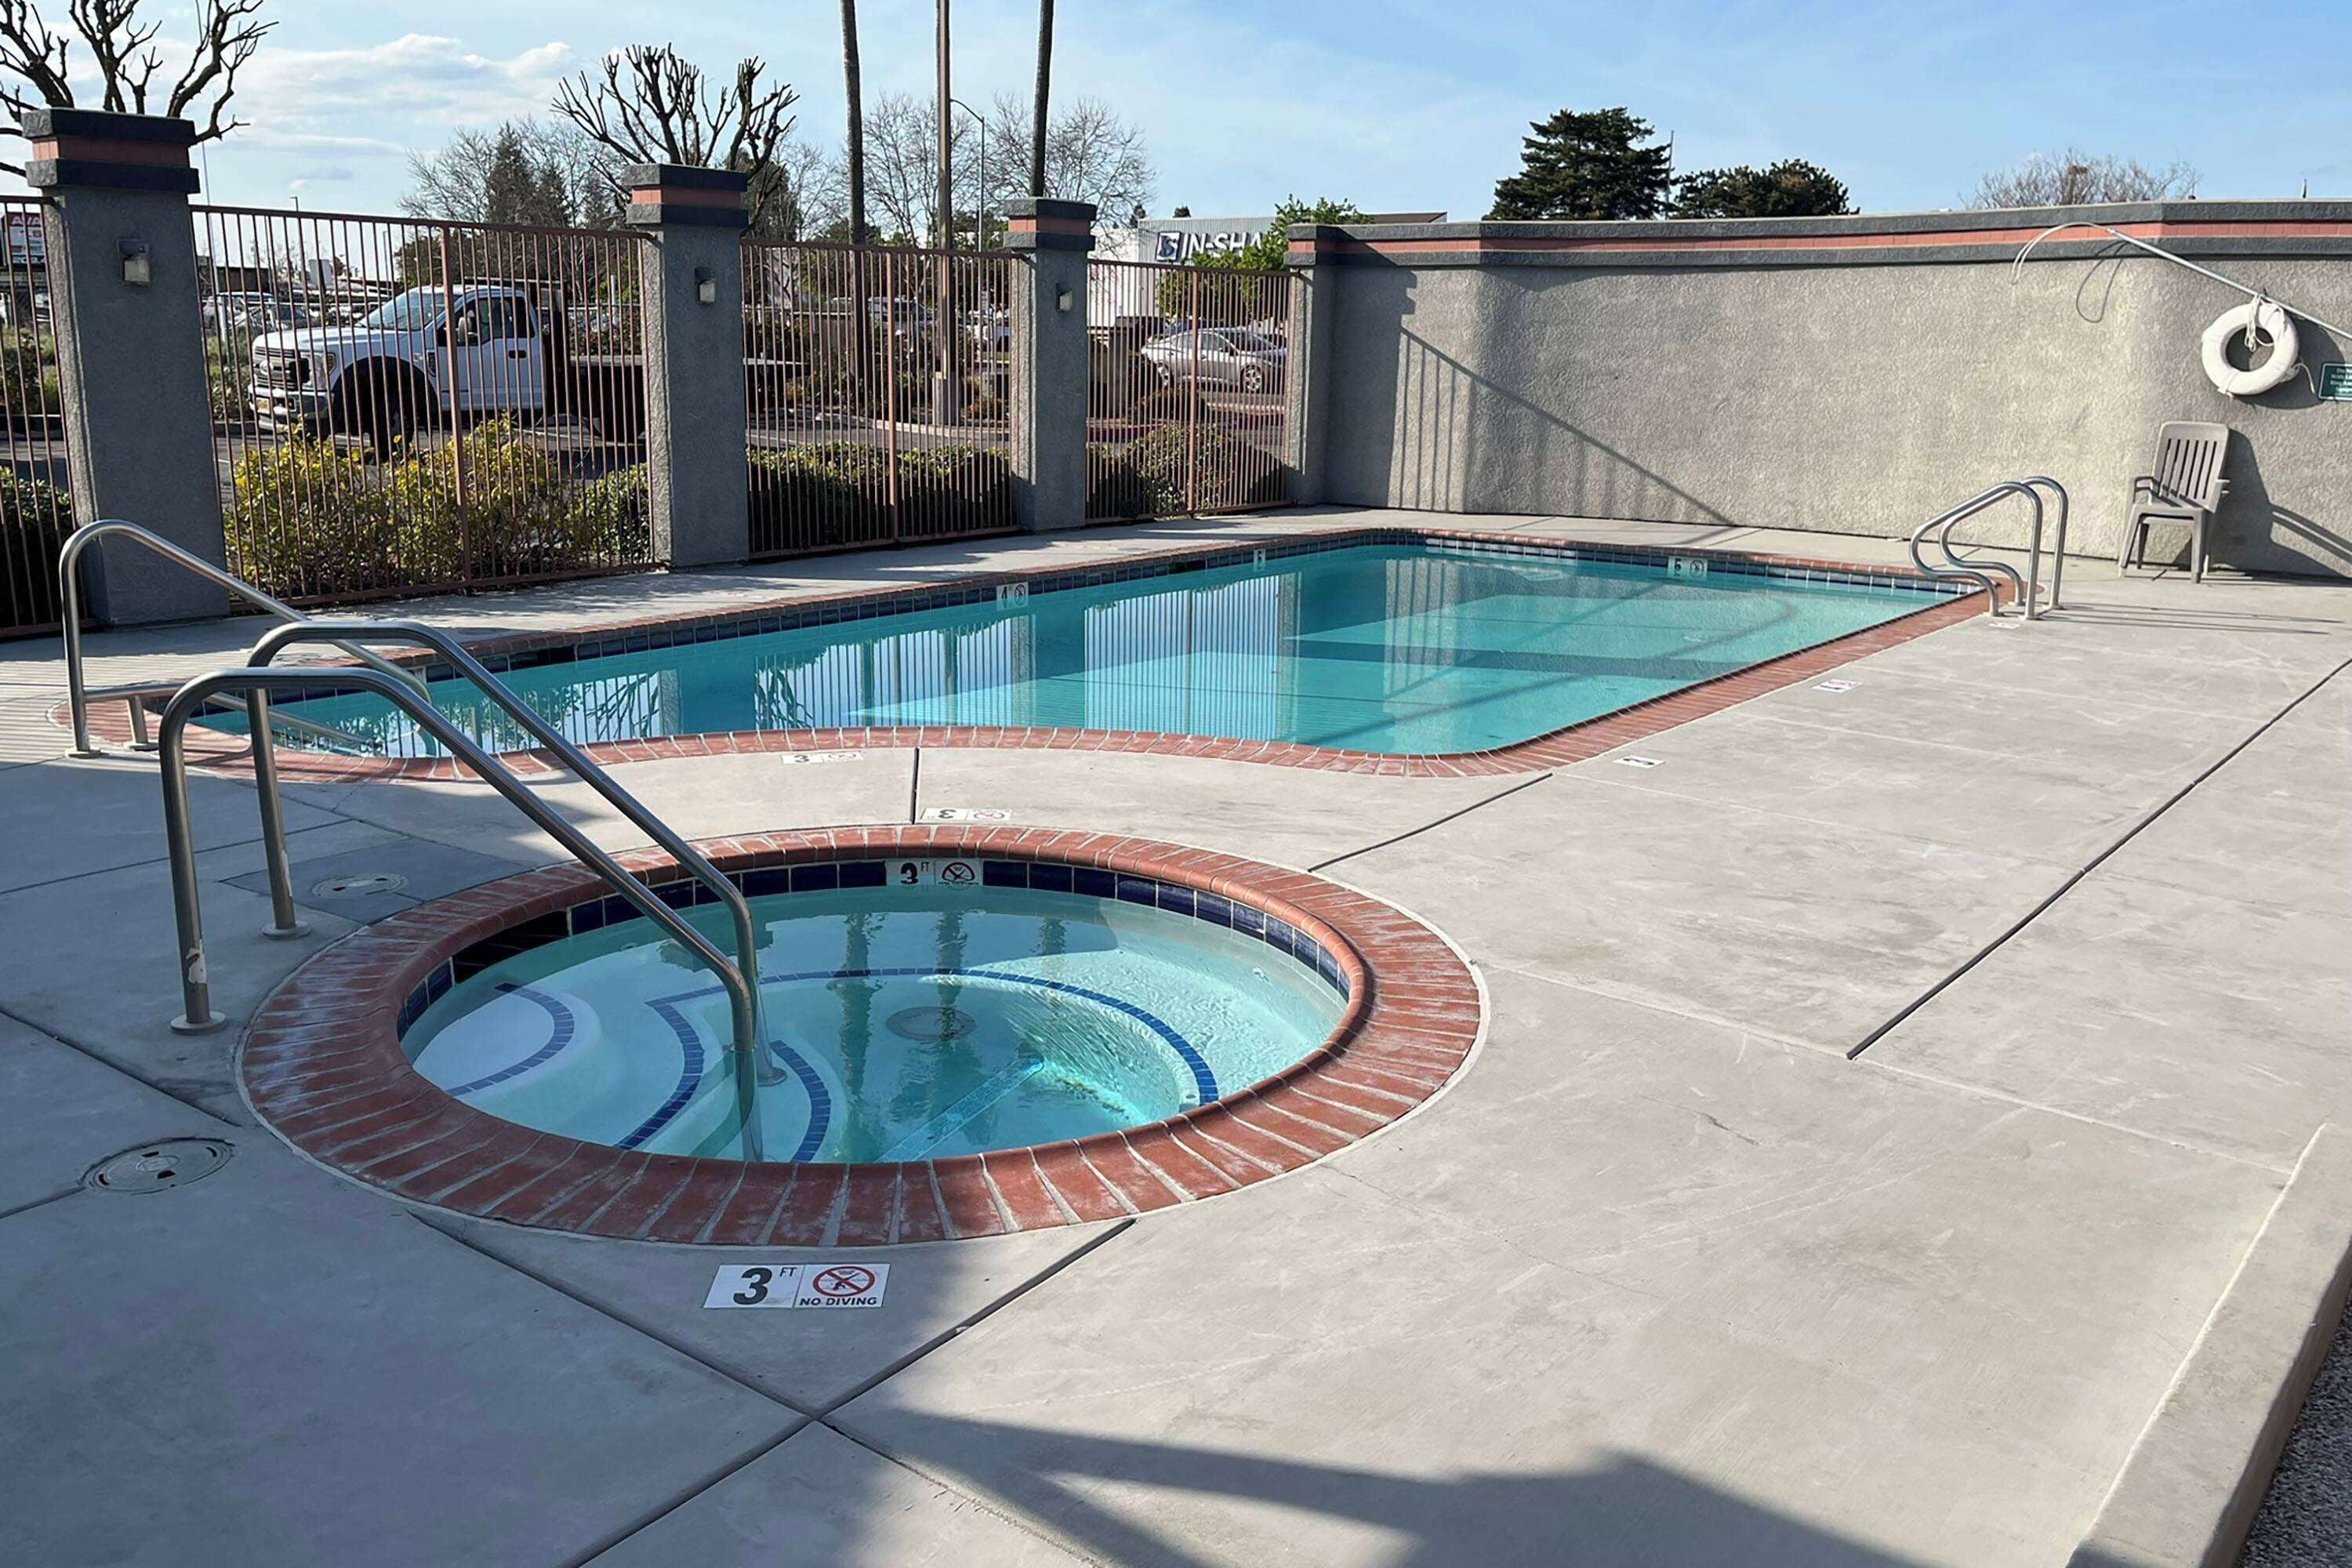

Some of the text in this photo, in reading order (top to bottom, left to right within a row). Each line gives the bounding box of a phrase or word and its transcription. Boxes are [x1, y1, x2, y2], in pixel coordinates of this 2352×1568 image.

[900, 862, 930, 884] 3 FT
[733, 1266, 797, 1305] 3 FT
[800, 1297, 877, 1306] NO DIVING
